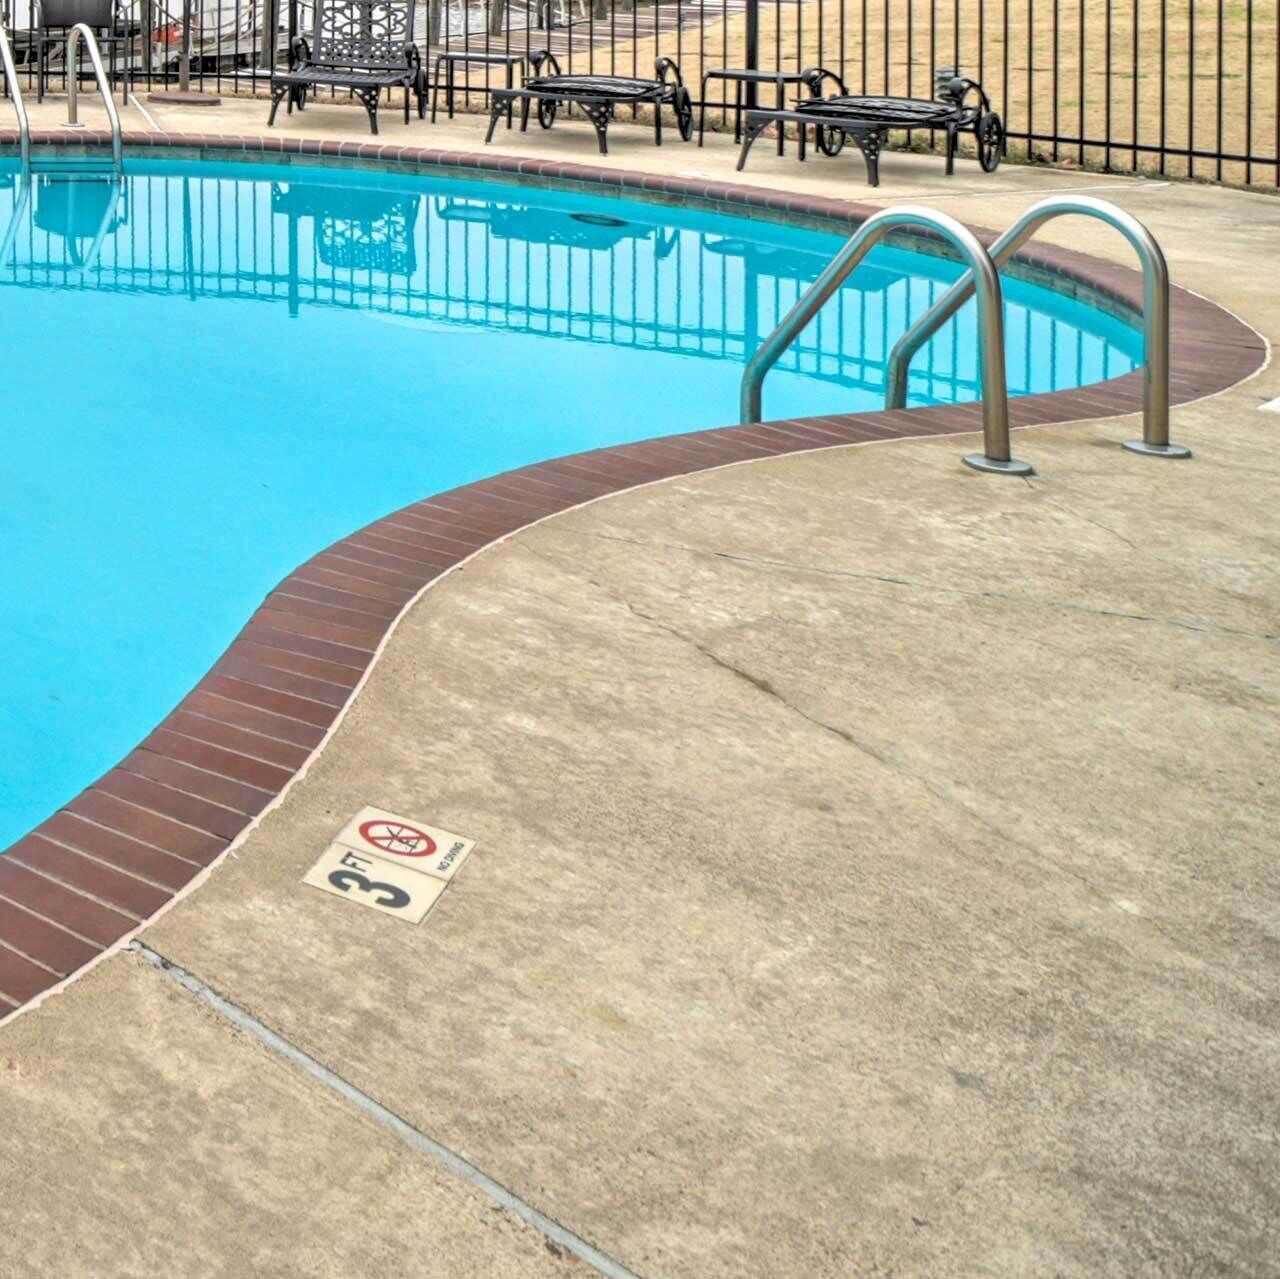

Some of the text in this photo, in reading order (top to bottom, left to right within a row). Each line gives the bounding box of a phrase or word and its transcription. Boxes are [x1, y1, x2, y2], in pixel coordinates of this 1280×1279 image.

[436, 841, 465, 872] NO DIVING
[328, 851, 411, 908] 3 FT
